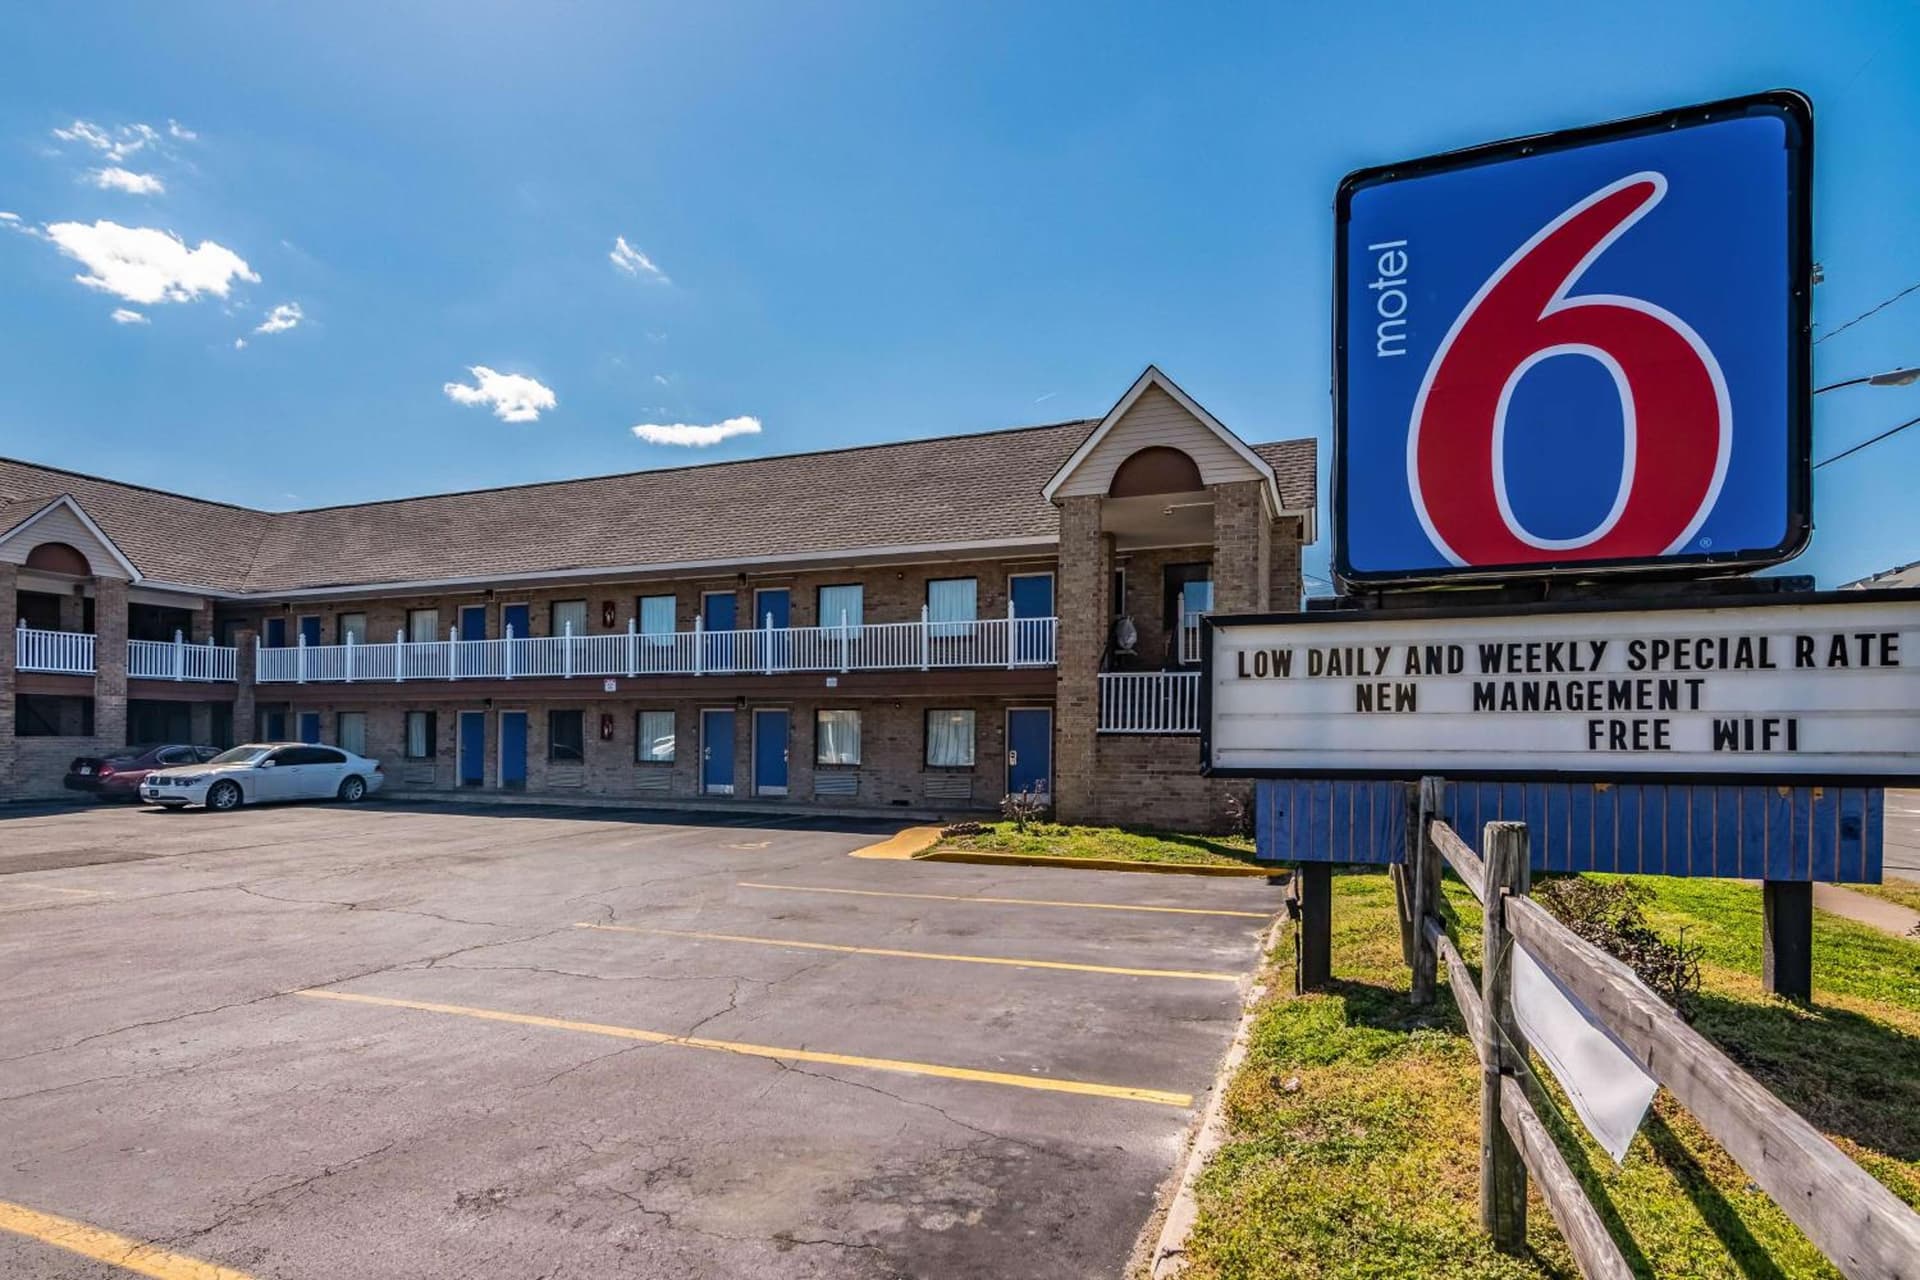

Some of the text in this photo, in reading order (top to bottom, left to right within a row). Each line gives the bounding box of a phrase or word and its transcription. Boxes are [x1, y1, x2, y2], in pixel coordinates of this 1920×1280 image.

[1367, 239, 1409, 358] motel
[1406, 170, 1734, 568] 6
[1237, 631, 1901, 679] LOW DAILY AND WEEKLY SPECIAL RATE
[1356, 678, 1706, 713] NEW MANAGEMENT
[1588, 718, 1799, 752] FREE WIFI
